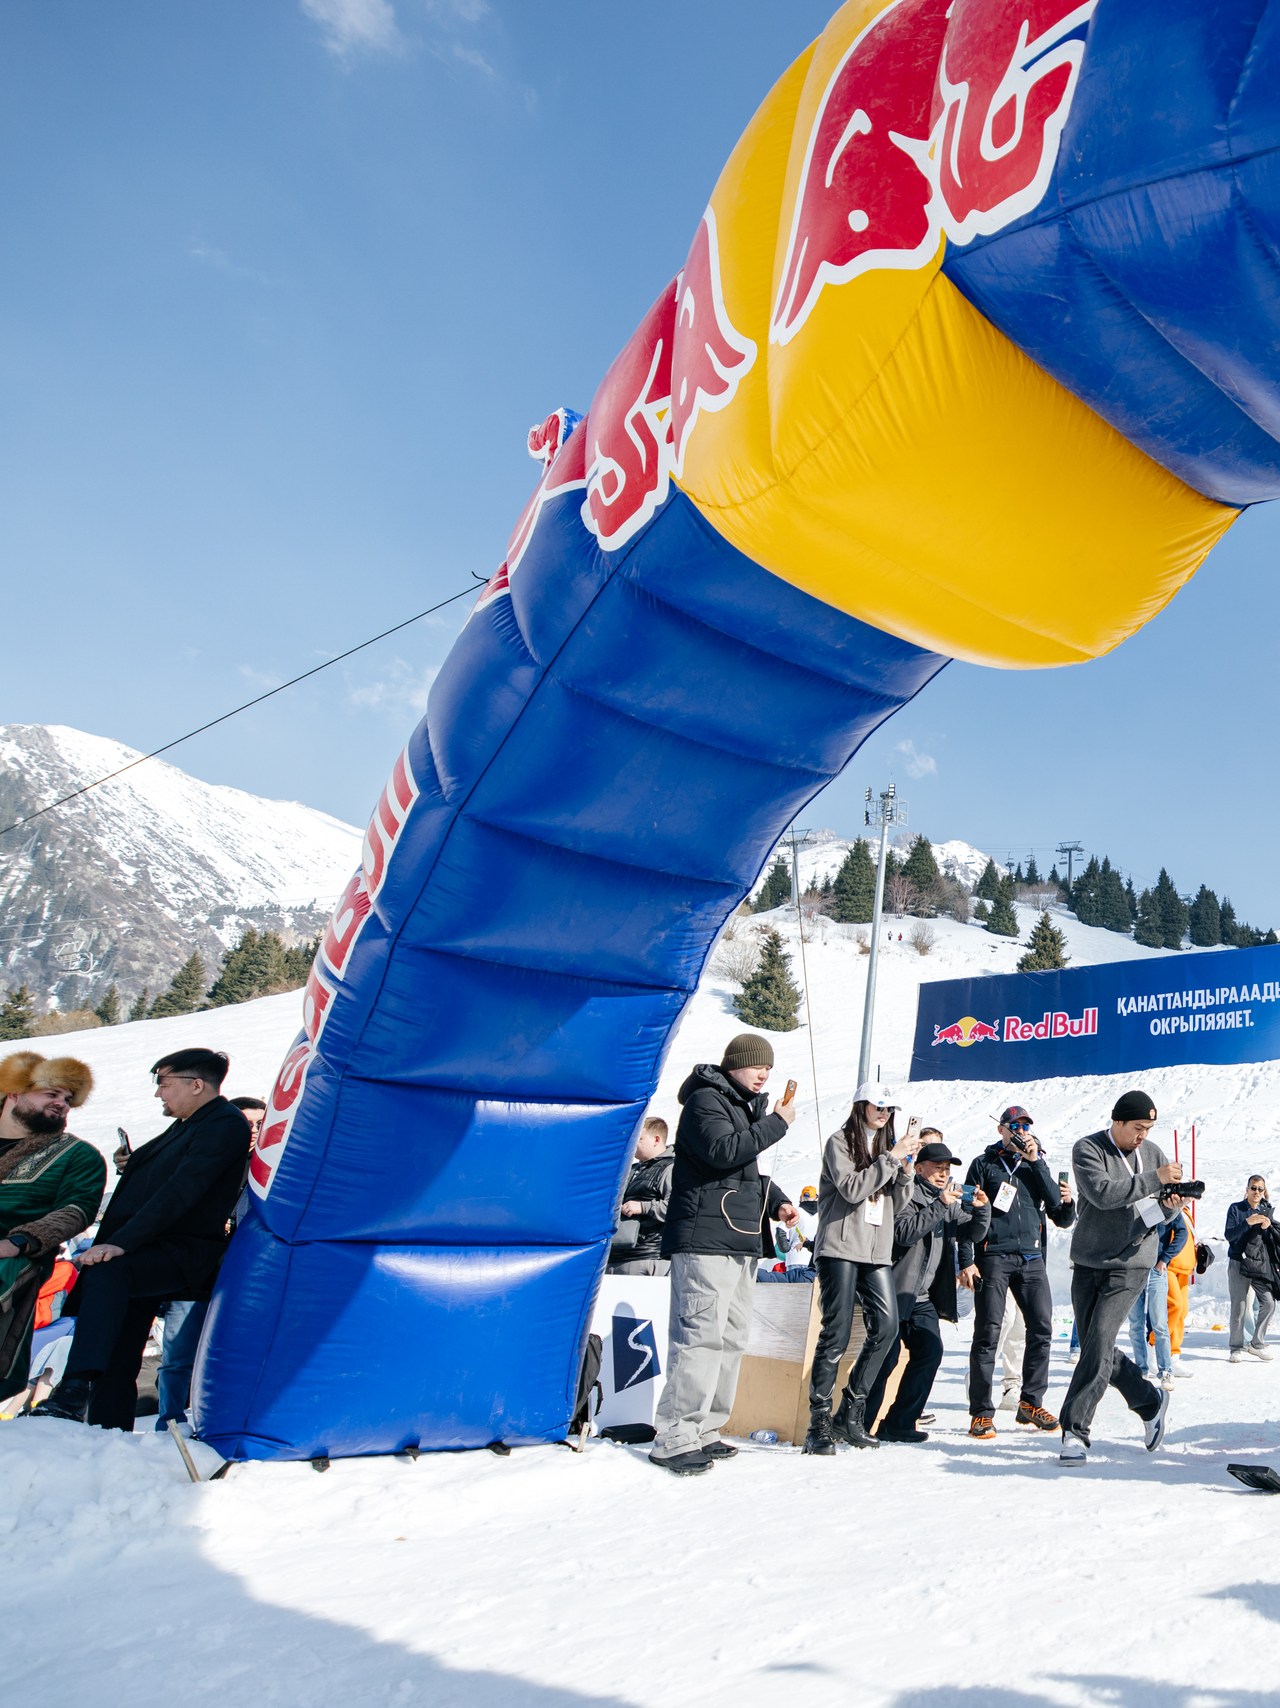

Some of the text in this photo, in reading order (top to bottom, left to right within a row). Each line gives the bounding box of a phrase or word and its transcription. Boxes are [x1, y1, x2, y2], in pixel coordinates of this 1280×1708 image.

[1004, 1007, 1098, 1041] Red Bull
[1149, 1009, 1254, 1036] ОКРЫЛЯЯЯЕТ.
